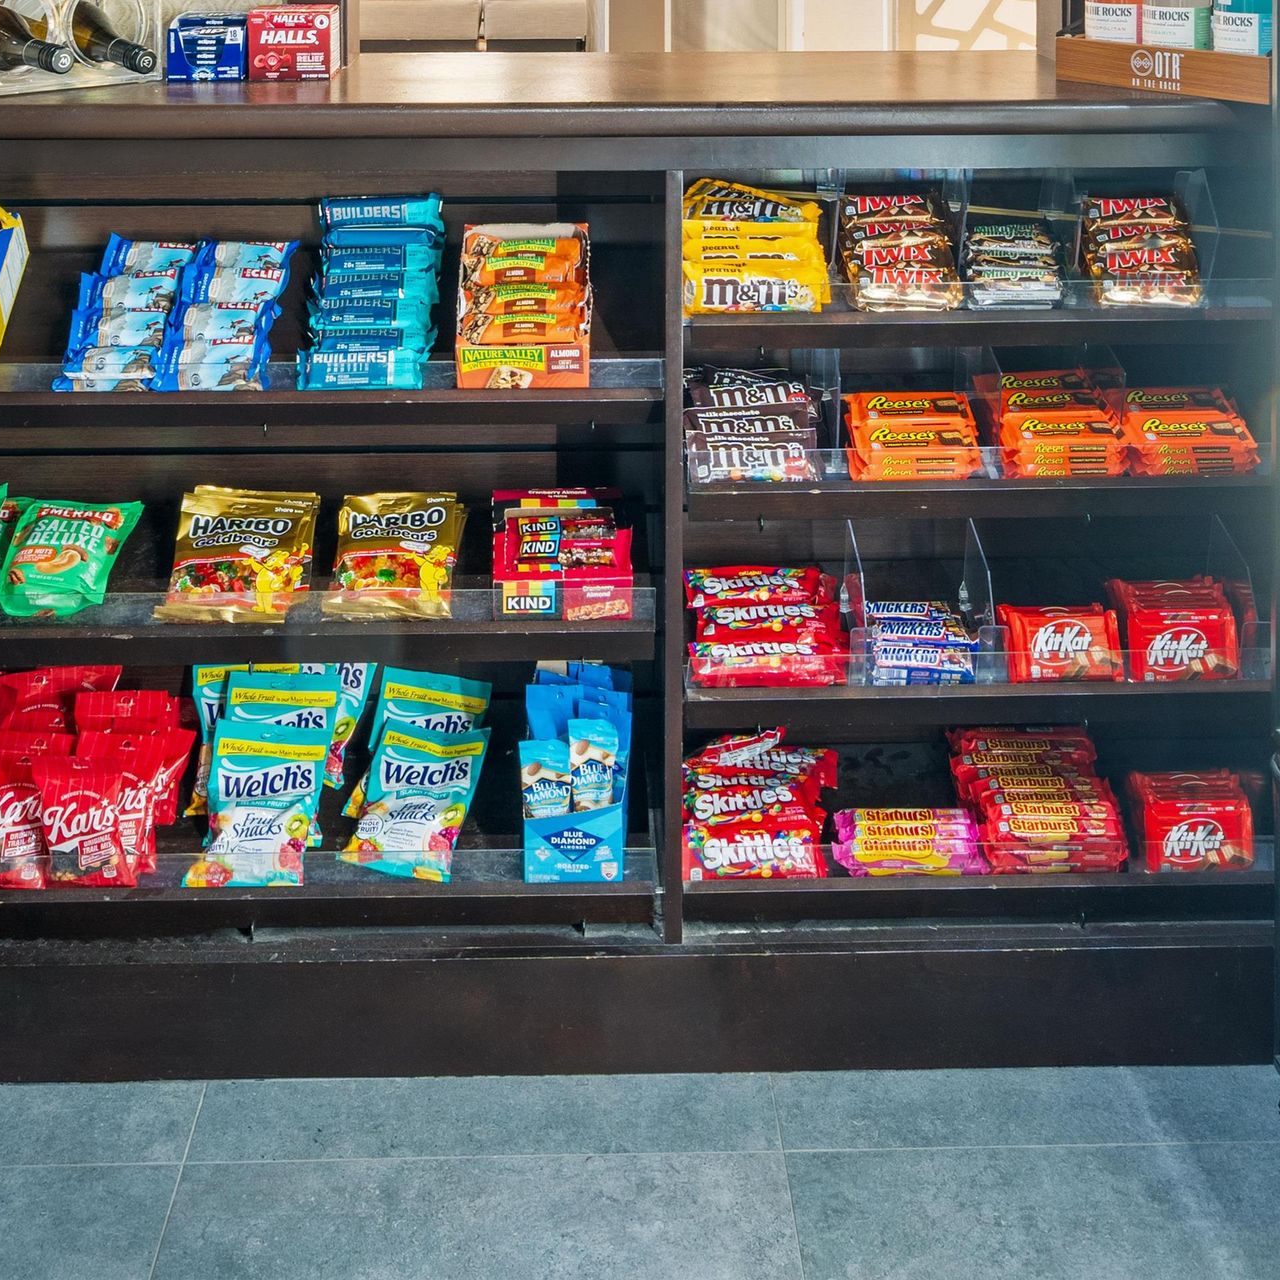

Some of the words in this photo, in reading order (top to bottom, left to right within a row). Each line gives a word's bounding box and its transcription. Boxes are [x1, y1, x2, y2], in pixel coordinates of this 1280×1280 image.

[1223, 16, 1253, 27] ROCKS
[296, 54, 324, 63] RELIEF
[1155, 51, 1181, 80] OTR
[333, 205, 401, 220] BUILDERS
[702, 224, 741, 233] peanut
[701, 244, 740, 252] peanut
[249, 268, 281, 280] CLIF
[703, 266, 743, 274] peanut
[328, 272, 399, 286] BUILDERS
[464, 349, 502, 362] NATURE
[502, 349, 543, 362] VALLEY
[550, 348, 580, 359] ALMOND
[1001, 375, 1059, 390] Reese's
[1007, 392, 1072, 407] Reese's
[1126, 389, 1190, 404] Reese's
[867, 396, 931, 413] Reese's
[697, 411, 720, 419] milk
[720, 409, 761, 418] chocolate
[1020, 418, 1087, 433] Reese's
[1142, 418, 1208, 433] Reese's
[727, 435, 770, 443] chocolate
[870, 427, 937, 443] Reese's
[1034, 443, 1065, 455] Reese's
[1158, 444, 1187, 455] Reese's
[881, 456, 912, 467] Reese's
[1034, 455, 1064, 466] Reese's
[882, 467, 914, 478] Reese's
[1035, 466, 1066, 477] Reese's
[40, 507, 115, 522] EMERALD
[35, 519, 106, 539] SALTED
[189, 516, 293, 539] HARIBO
[351, 528, 438, 541] Goldbears
[521, 522, 558, 533] KIND
[26, 531, 103, 554] DELUXE
[193, 533, 280, 551] Goldbears
[521, 541, 556, 554] KIND
[703, 575, 803, 595] Skittles
[507, 596, 552, 610] KIND
[866, 601, 928, 615] SNICKERS
[716, 604, 819, 625] Skittles
[879, 625, 945, 638] SNICKERS
[710, 642, 816, 658] Skittles
[987, 738, 1050, 751] Starburst
[973, 752, 1037, 765] Starburst
[384, 760, 469, 786] Welch's
[580, 764, 601, 777] BLUE
[988, 766, 1052, 777] Starburst
[222, 766, 313, 799] Welch's
[532, 782, 560, 794] BLUE
[697, 773, 790, 789] Skittles
[999, 776, 1065, 789] Starburst
[522, 785, 572, 803] DIAMOND
[1005, 791, 1072, 803] Starburst
[694, 785, 797, 821] Skittles
[1011, 803, 1080, 817] Starburst
[242, 812, 277, 827] Fruit
[384, 809, 437, 823] Snacks
[865, 810, 934, 822] Starburst
[232, 821, 284, 839] Snacks
[866, 824, 936, 837] Starburst
[1009, 819, 1079, 833] Starburst
[81, 833, 112, 847] ORIGINAL
[551, 836, 596, 845] DIAMOND
[702, 832, 806, 870] Skittles
